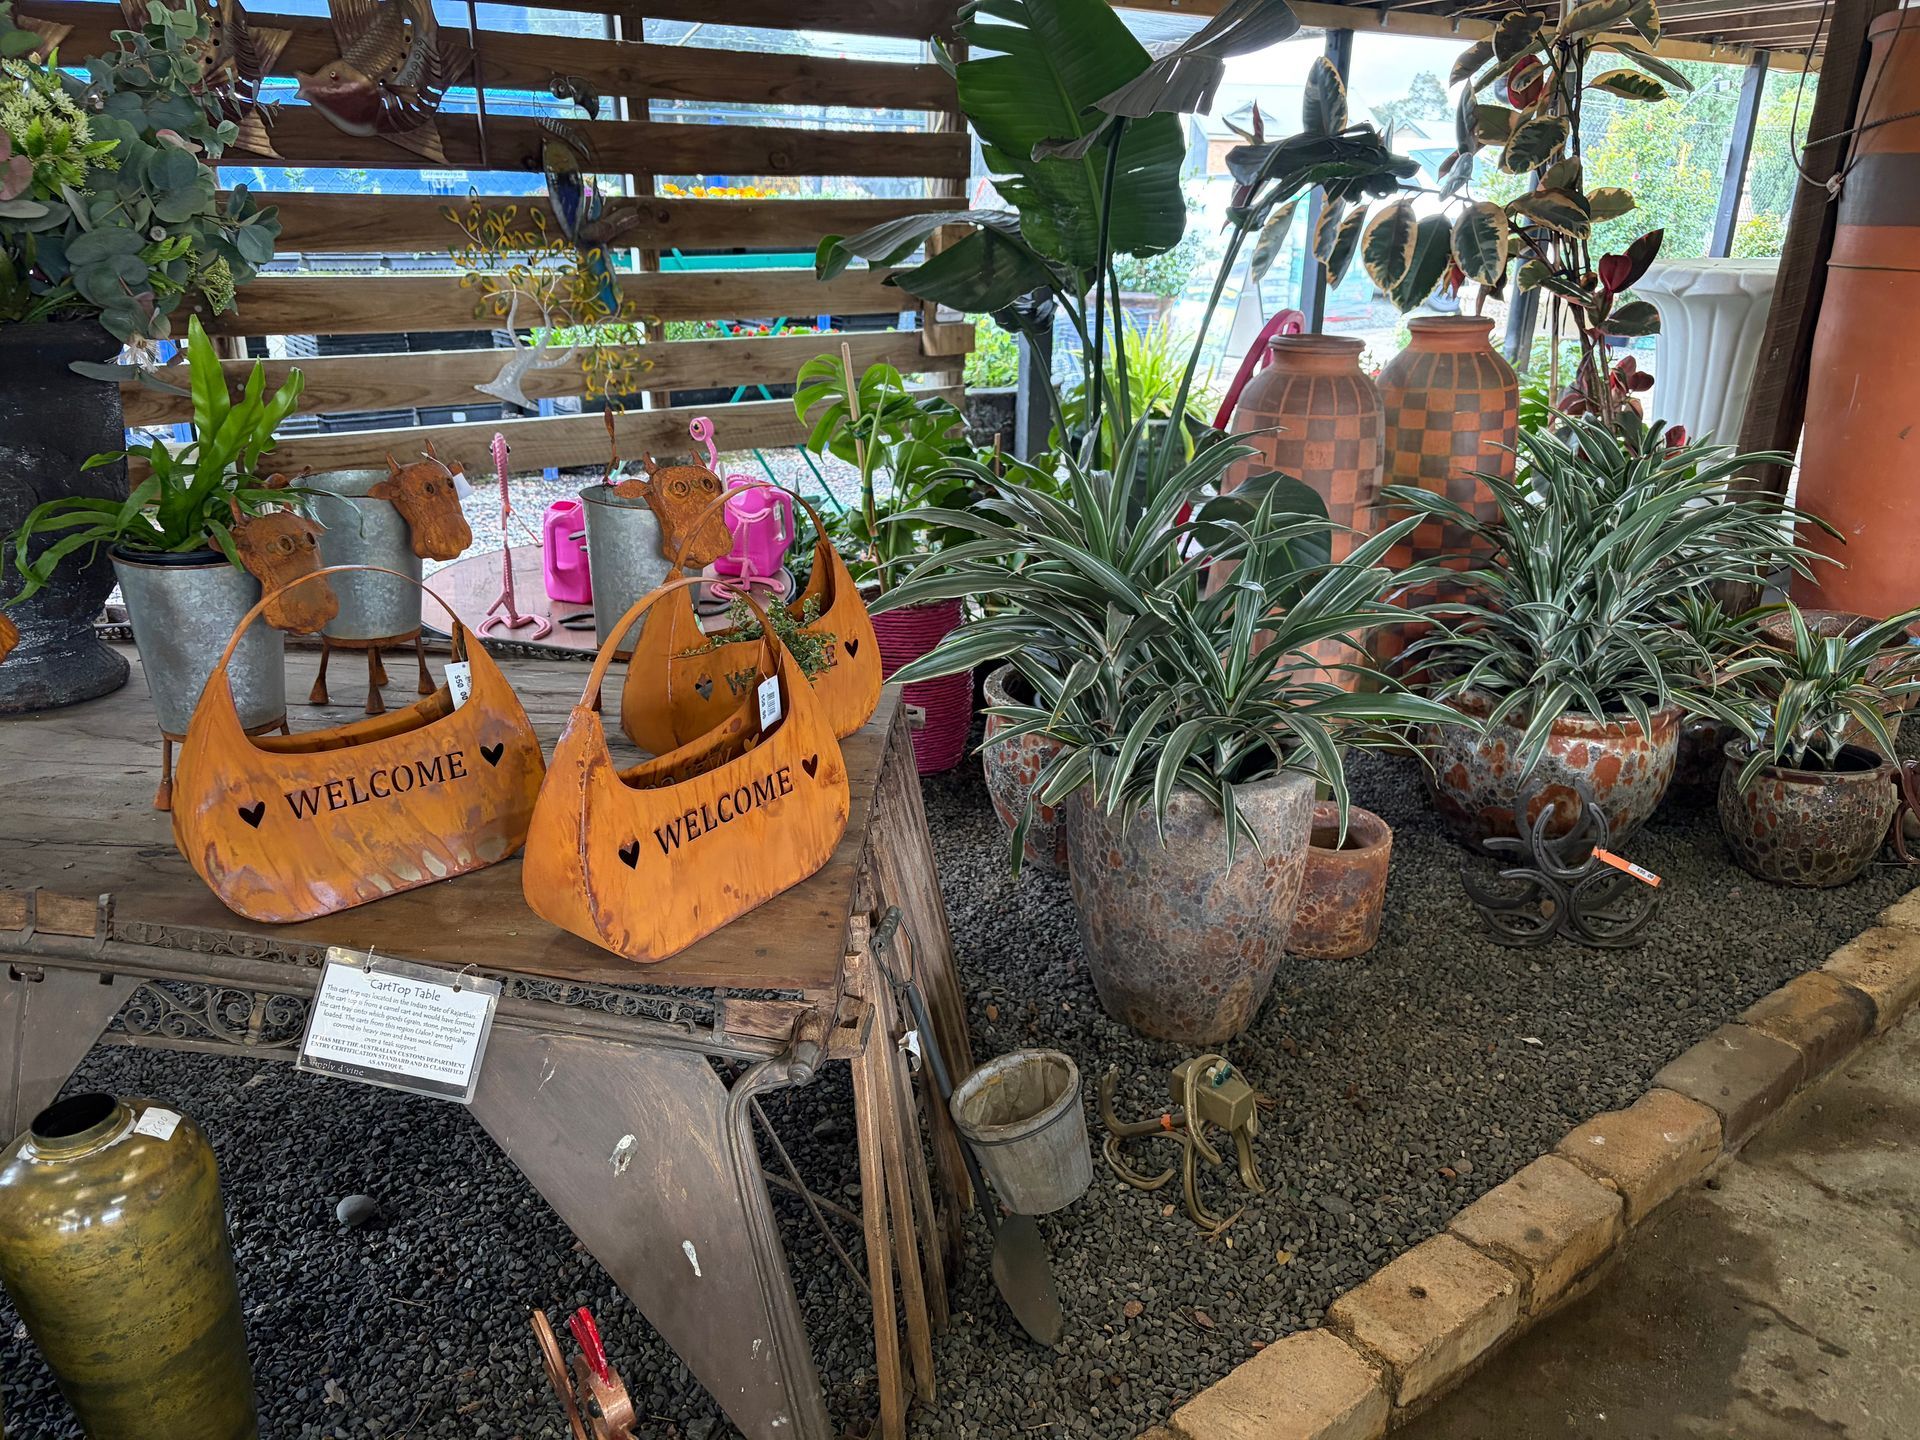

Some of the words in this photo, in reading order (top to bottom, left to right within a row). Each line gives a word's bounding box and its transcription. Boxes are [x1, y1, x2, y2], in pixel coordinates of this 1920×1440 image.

[284, 751, 468, 819] WELCOME
[653, 766, 793, 855] WELCOME
[351, 989, 360, 997] top
[372, 992, 392, 1002] located
[410, 1001, 427, 1009] Indian
[415, 987, 440, 1001] Table
[364, 1000, 378, 1008] from
[441, 1015, 454, 1023] have
[455, 1018, 475, 1028] formed
[369, 1010, 385, 1018] which
[363, 1026, 378, 1036] heavy
[404, 1034, 417, 1042] brass
[433, 1040, 453, 1050] formed
[370, 1018, 384, 1027] from
[445, 1035, 467, 1045] typically
[331, 1045, 377, 1057] CERTIFICATION
[379, 1055, 409, 1064] STANDARD
[430, 1065, 464, 1075] CLASSIFIED
[360, 1044, 396, 1054] AUSTRALIAN
[398, 1051, 425, 1060] CUSTOMS
[427, 1057, 465, 1068] DEPARTMENT
